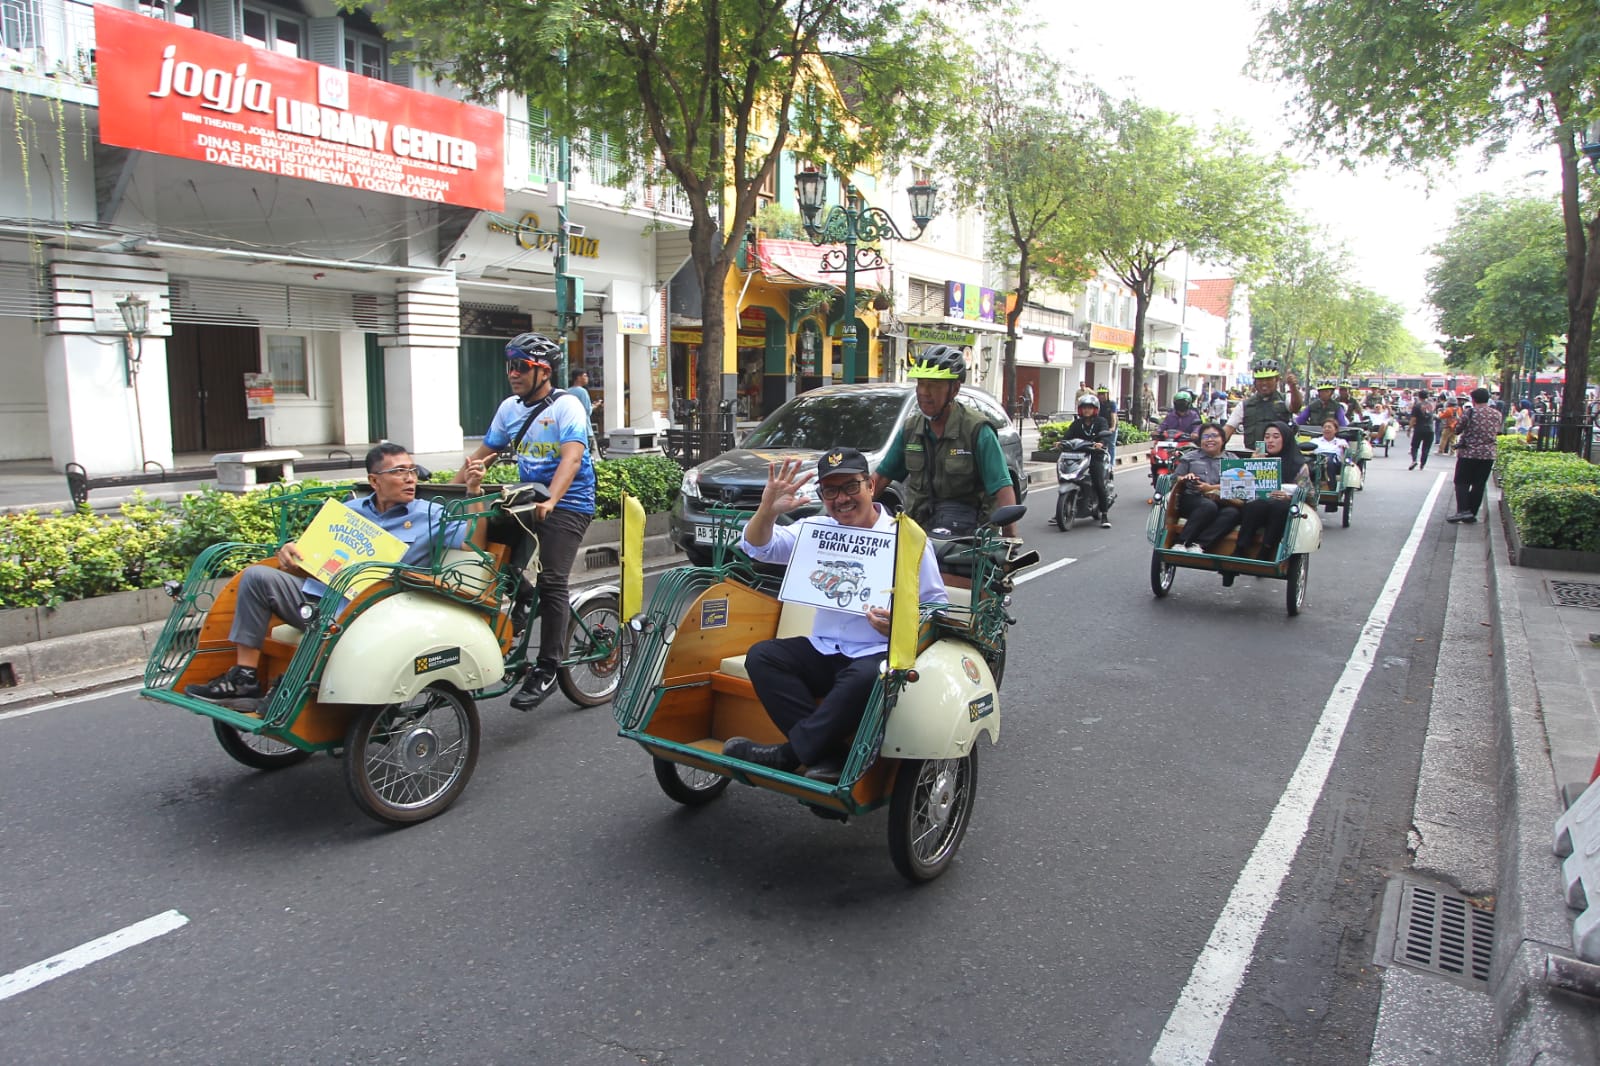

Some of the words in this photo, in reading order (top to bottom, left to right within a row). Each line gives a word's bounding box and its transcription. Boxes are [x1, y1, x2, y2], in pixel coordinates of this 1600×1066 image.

[148, 44, 273, 114] jogja
[182, 112, 202, 125] MINI
[203, 116, 247, 134] THEATER,
[248, 126, 276, 140] JOGJA
[395, 156, 438, 171] COLLECTION
[438, 165, 459, 175] ROOM
[261, 136, 290, 151] BALAI
[291, 142, 334, 160] LAYANAN
[335, 151, 402, 174] PERPUSTAKAAN
[276, 96, 388, 151] LIBRARY
[392, 124, 477, 171] CENTER
[197, 133, 241, 152] DINAS
[244, 142, 344, 171] PERPUSTAKAAN
[347, 161, 371, 177] DAN
[373, 167, 405, 183] ARSIP
[406, 173, 449, 191] DAERAH
[205, 148, 277, 173] DAERAH
[281, 162, 353, 187] ISTIMEWA
[355, 177, 446, 202] YOGYAKARTA
[329, 524, 375, 556] MALIOBORO
[339, 534, 359, 549] MISS
[356, 546, 366, 555] U
[811, 529, 848, 543] BECAK
[848, 534, 891, 549] LISTRIK
[818, 540, 850, 553] BIKIN
[851, 545, 879, 557] ASIK
